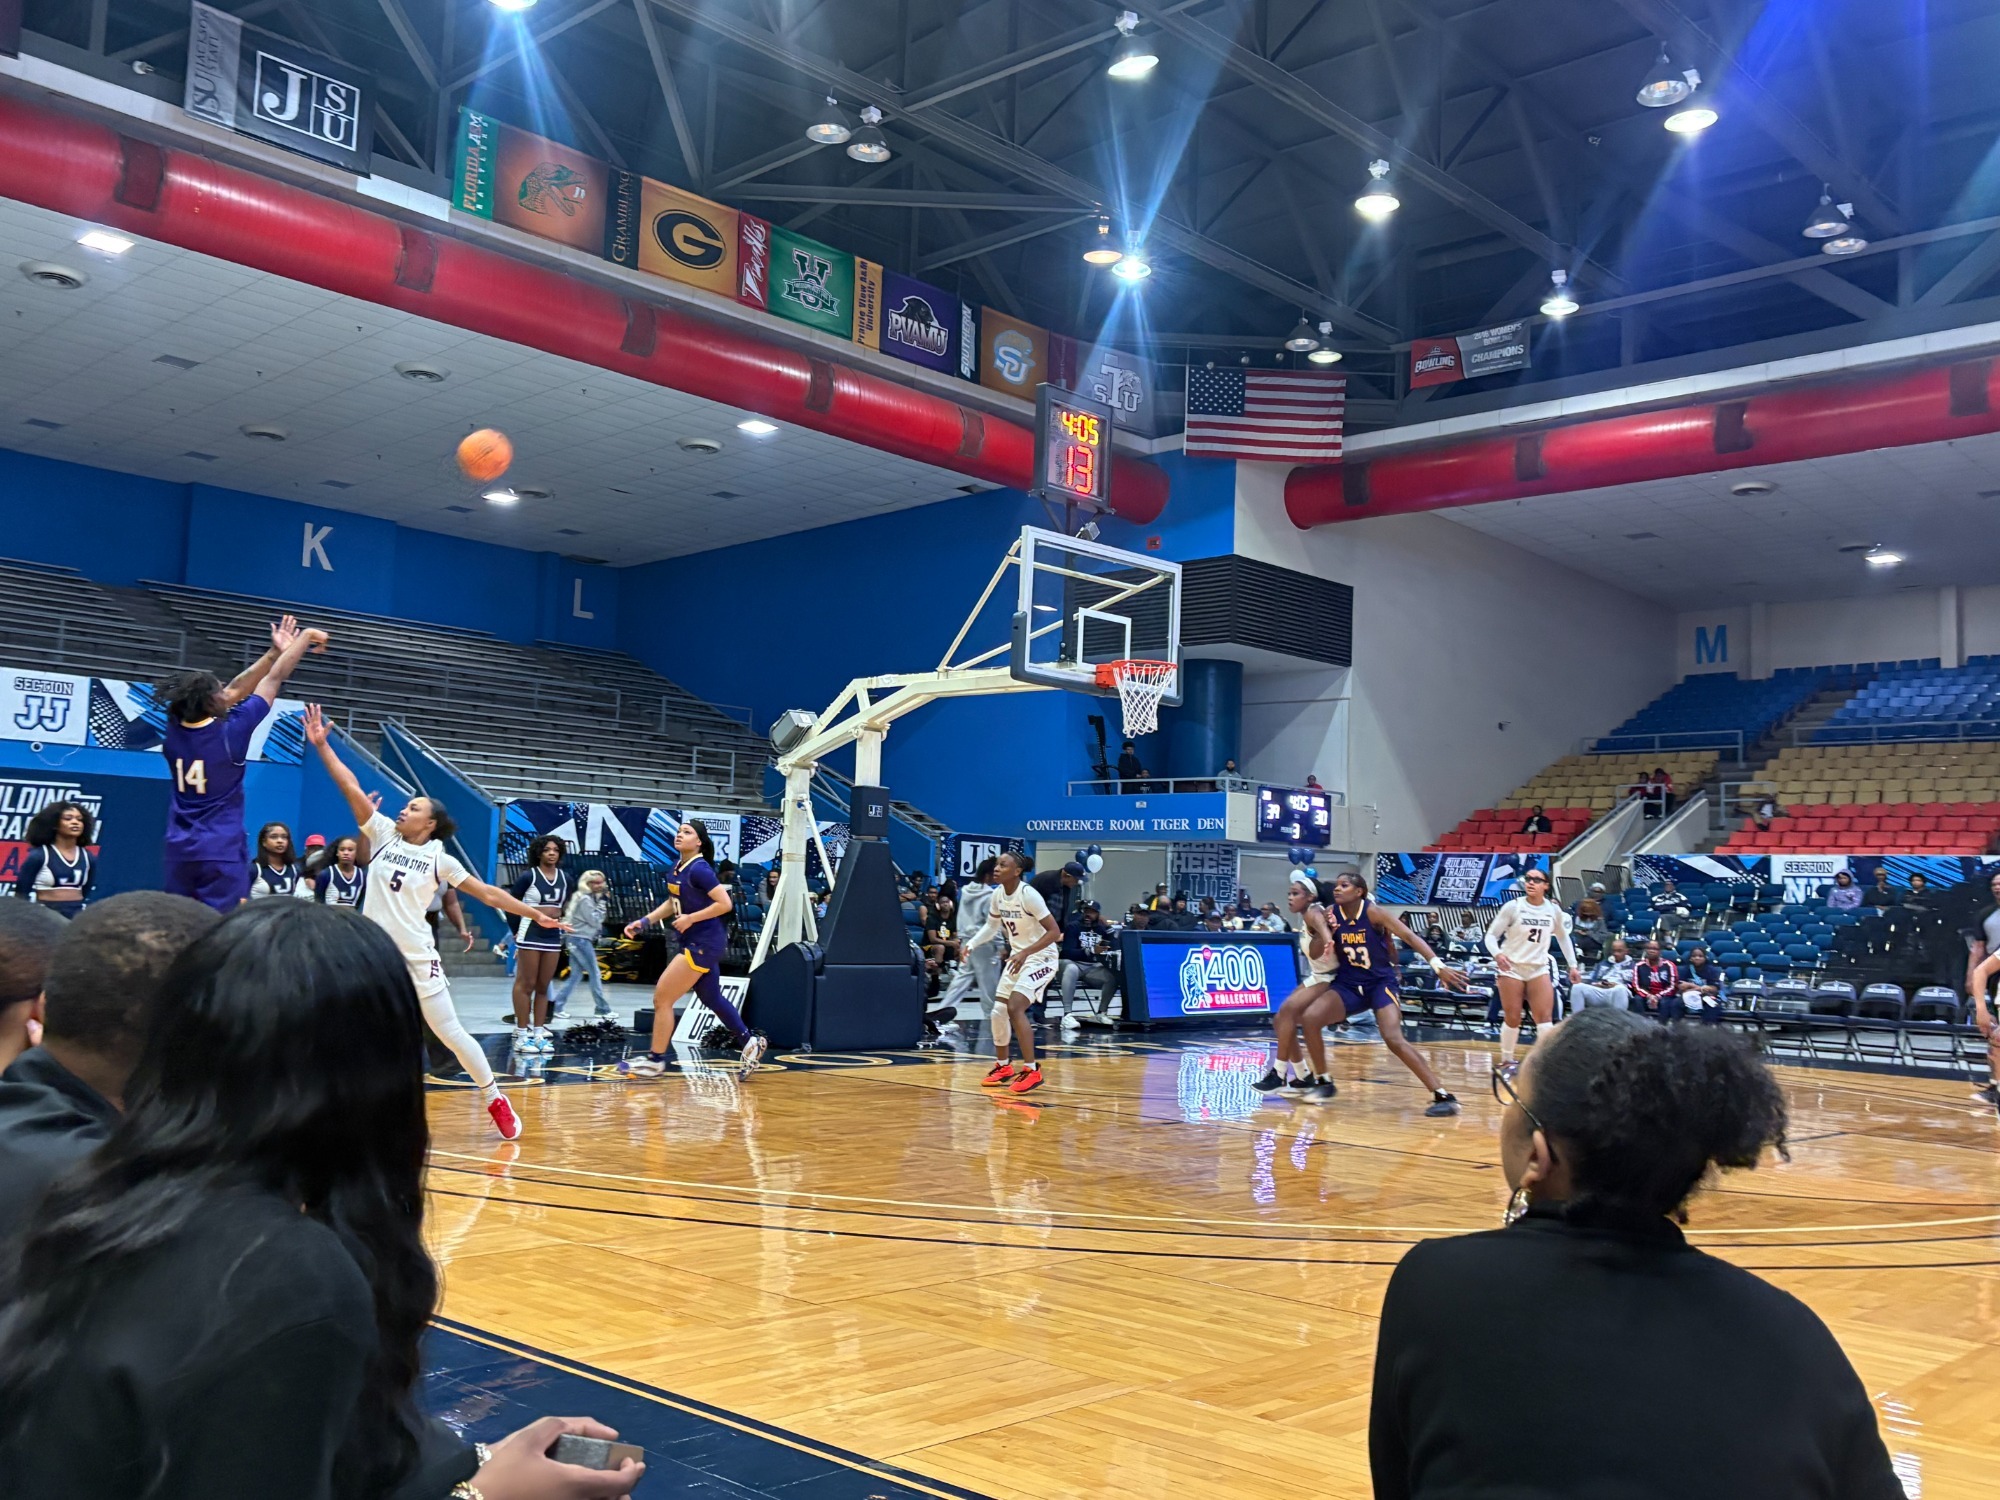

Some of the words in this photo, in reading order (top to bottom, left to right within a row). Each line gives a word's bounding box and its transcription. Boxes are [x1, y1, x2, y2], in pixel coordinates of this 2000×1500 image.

[463, 146, 480, 211] FLORIDA
[655, 211, 725, 269] G
[860, 260, 868, 283] A&M
[866, 280, 876, 331] University
[858, 311, 866, 345] Prairie
[889, 311, 948, 356] PVAMU
[961, 301, 973, 379] SOUTHERN
[1414, 355, 1455, 373] BOWLING
[1471, 344, 1525, 363] CHAMPIONS
[1062, 411, 1099, 446] 4:05
[1066, 445, 1093, 494] 13
[301, 522, 335, 572] K
[572, 578, 595, 620] L
[1696, 624, 1728, 664] M
[14, 677, 74, 695] SECTION
[15, 694, 70, 732] JJ
[175, 758, 208, 794] 14
[1026, 818, 1104, 831] CONFERENCE
[1109, 818, 1145, 831] ROOM
[1151, 817, 1191, 831] TIGER
[1197, 817, 1225, 830] DEN
[1314, 810, 1328, 826] 30
[389, 870, 406, 892] 5
[409, 857, 430, 874] STATE
[1784, 861, 1833, 873] SECTION
[1527, 928, 1542, 943] 21
[1190, 950, 1262, 991] 1400
[1214, 993, 1262, 1005] COLLECTIVE
